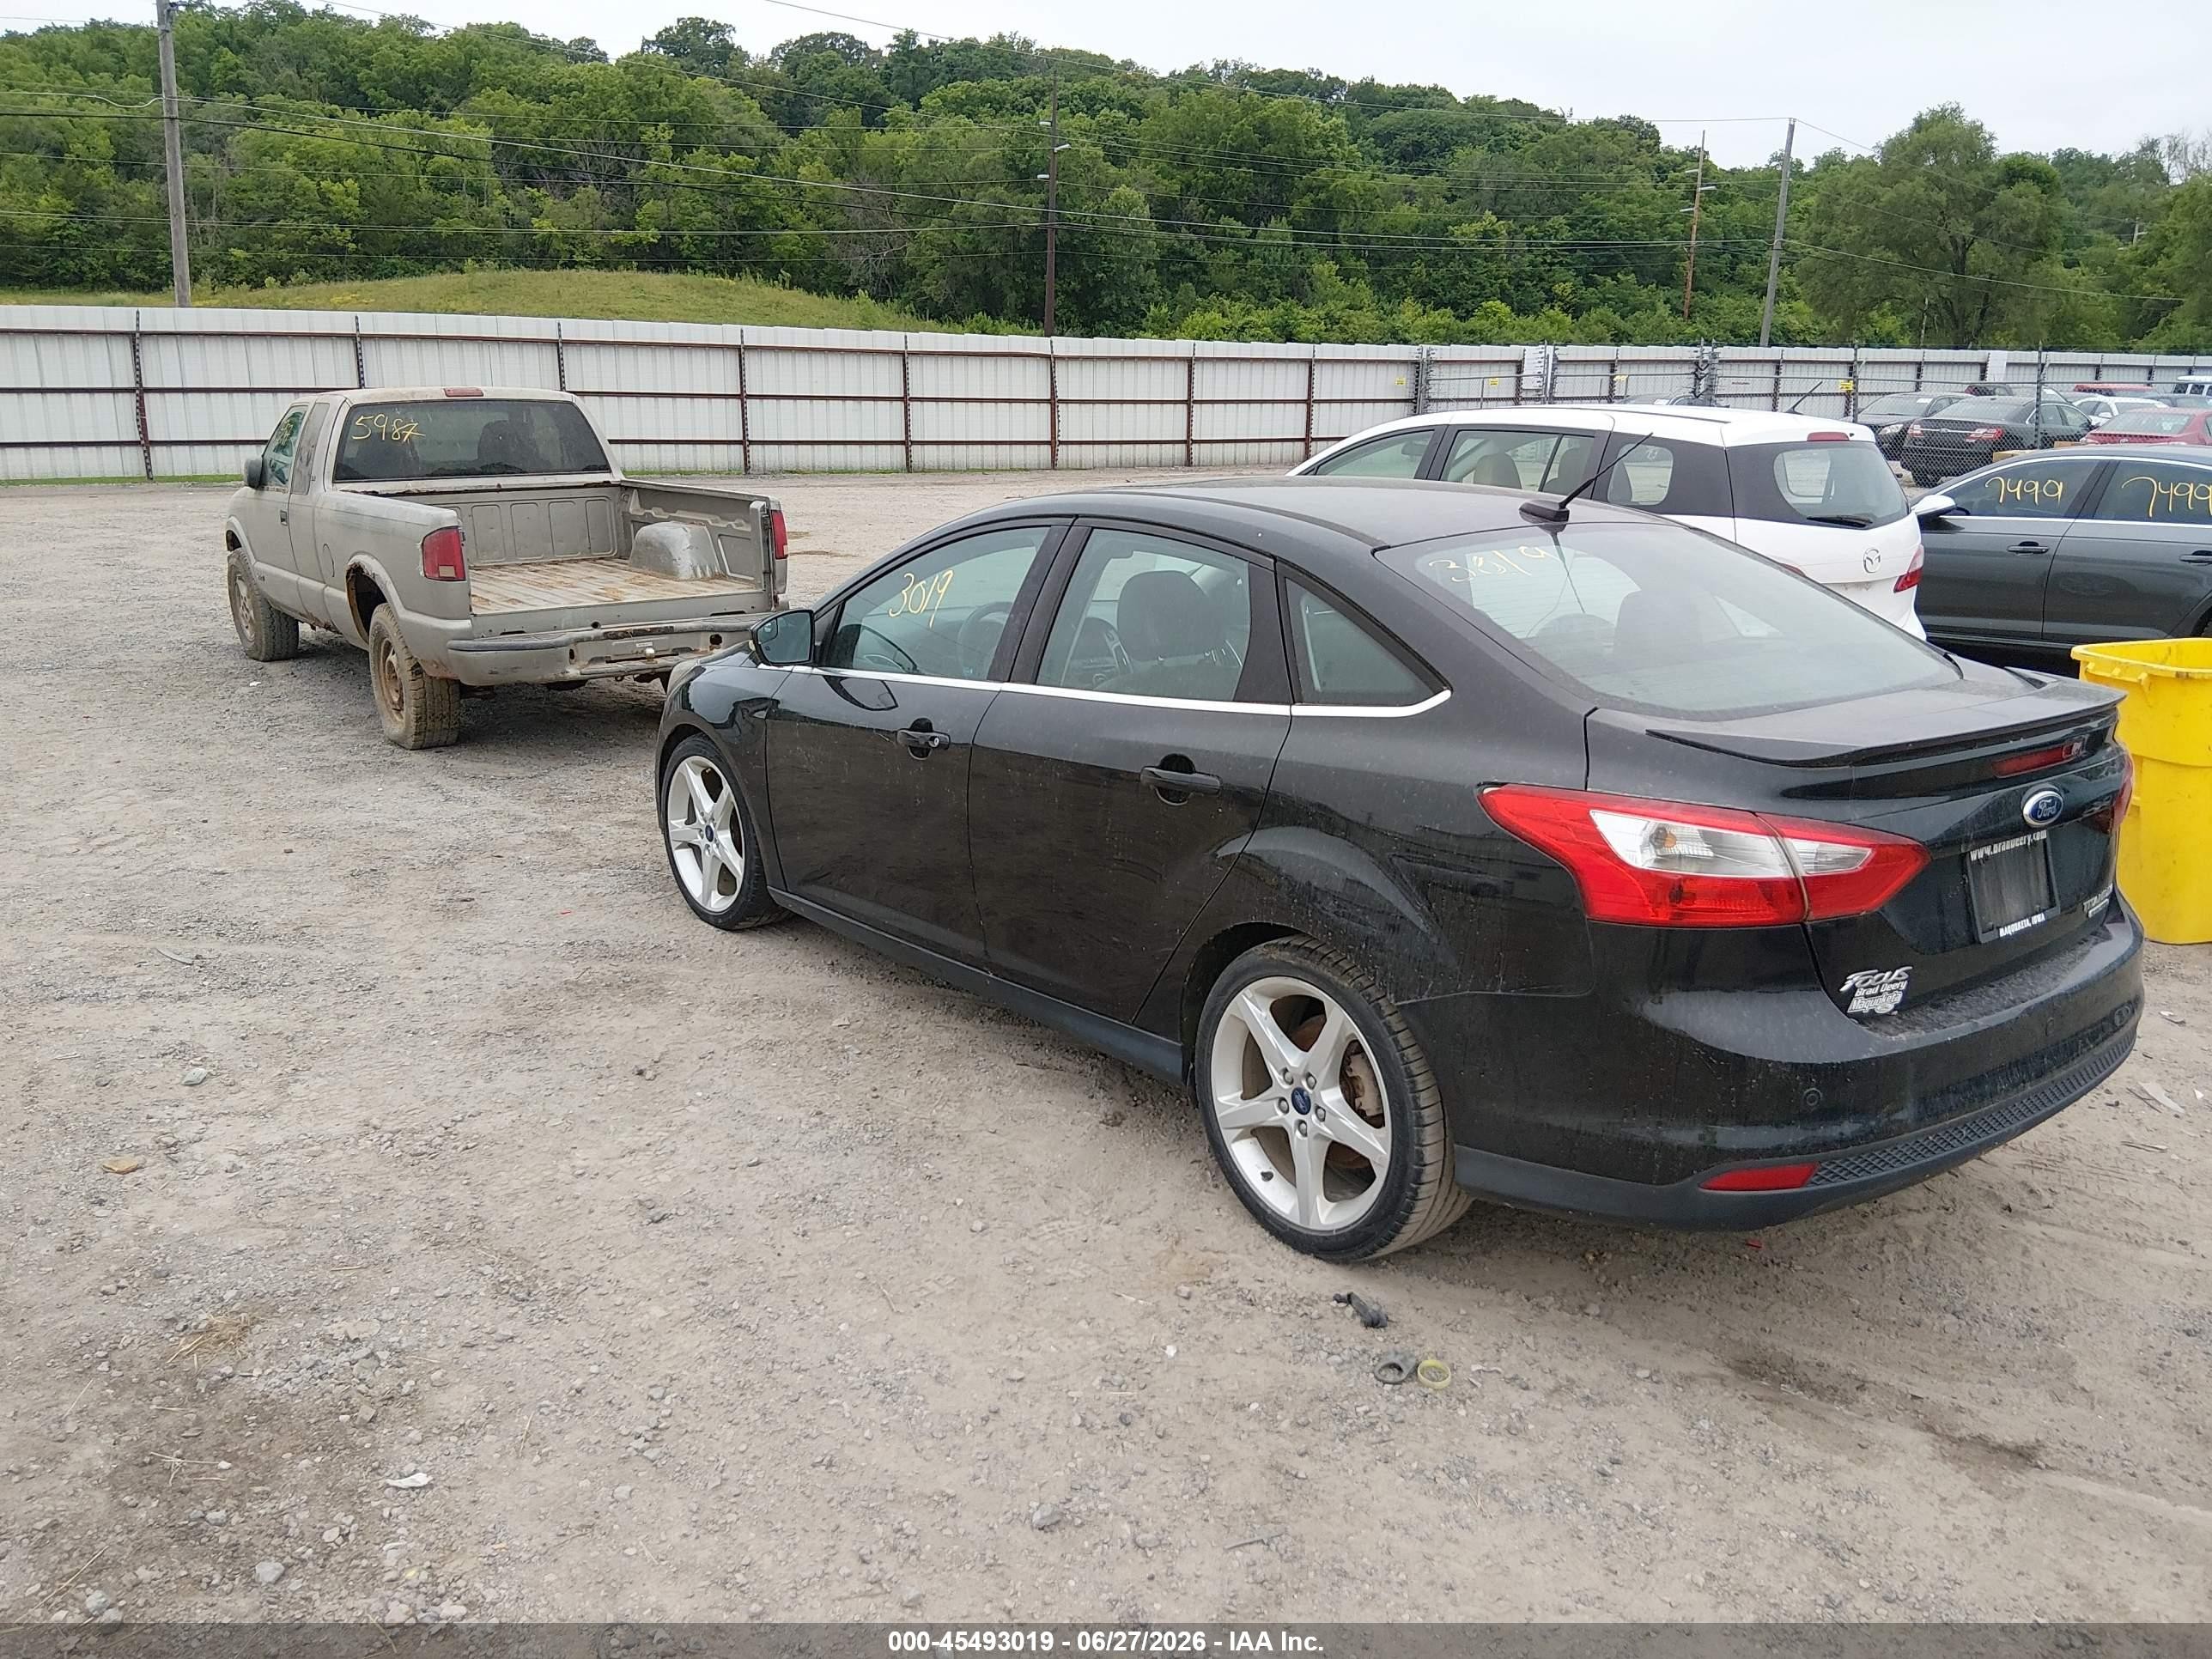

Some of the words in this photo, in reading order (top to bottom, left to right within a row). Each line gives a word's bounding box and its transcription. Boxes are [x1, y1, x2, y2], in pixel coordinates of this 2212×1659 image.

[351, 414, 426, 442] 5987
[1984, 477, 2063, 507] 7499
[2121, 476, 2212, 518] 7499
[888, 569, 953, 629] 3019
[2037, 799, 2057, 818] Ford
[1855, 985, 1880, 997] Brad
